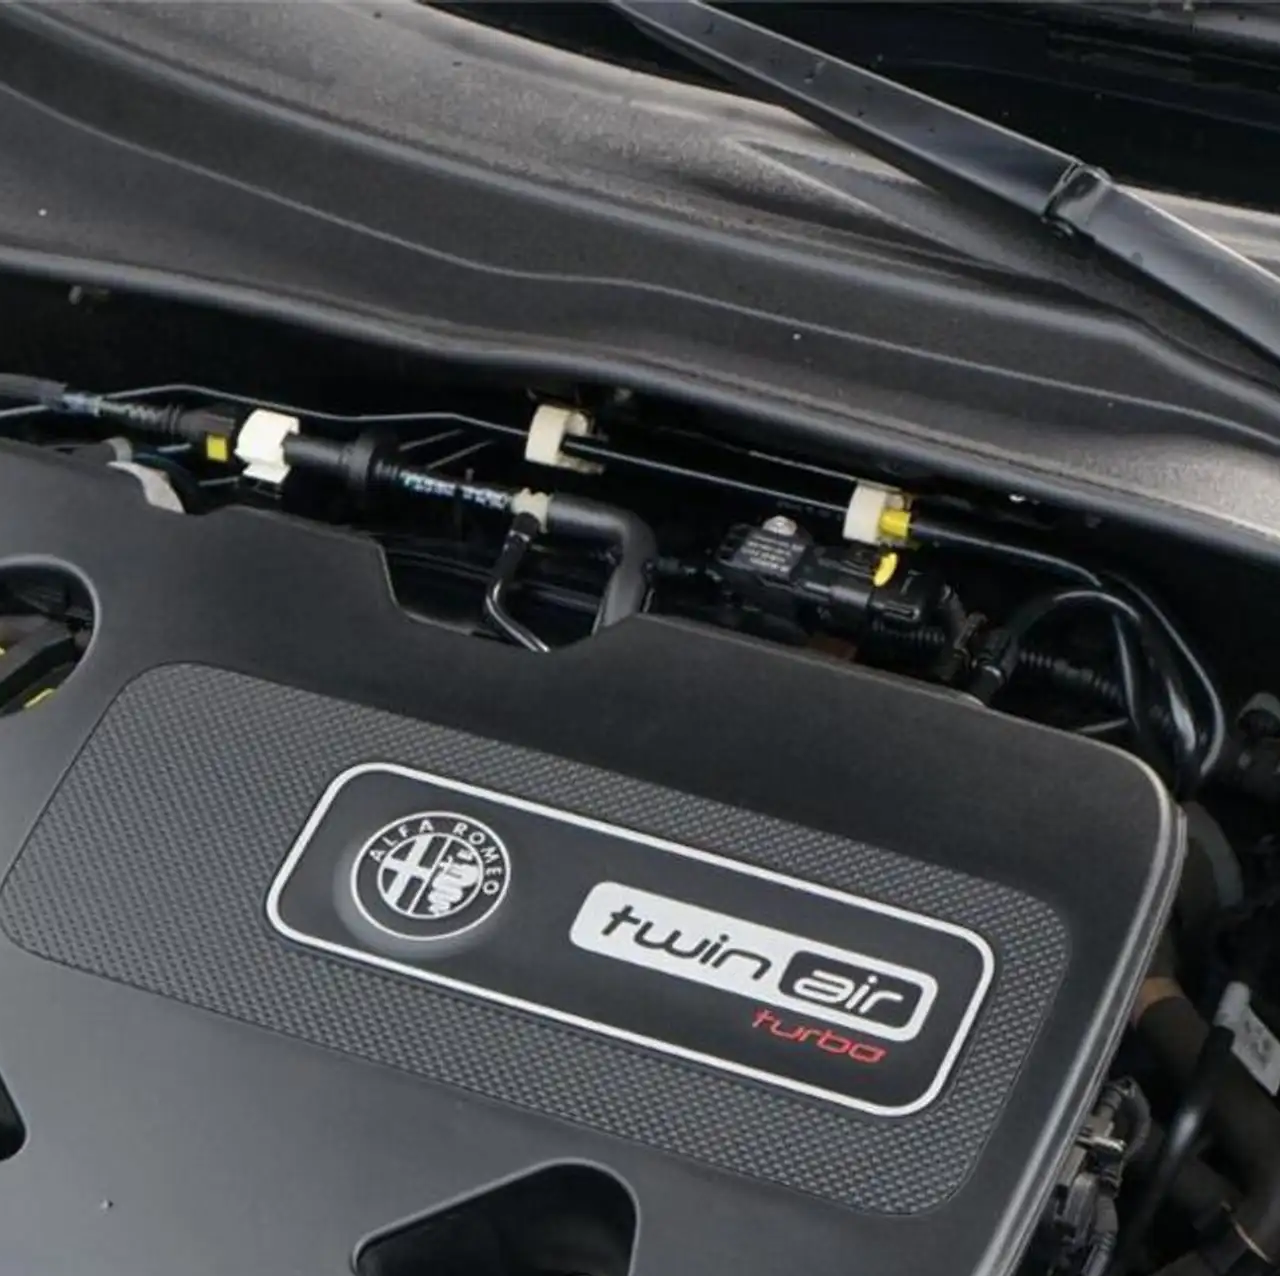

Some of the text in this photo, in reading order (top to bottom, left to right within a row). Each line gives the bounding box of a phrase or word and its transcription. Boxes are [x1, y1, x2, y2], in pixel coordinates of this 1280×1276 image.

[369, 819, 503, 896] ALFA ROMEO
[601, 904, 904, 1014] twin air
[752, 1008, 886, 1063] turbo
